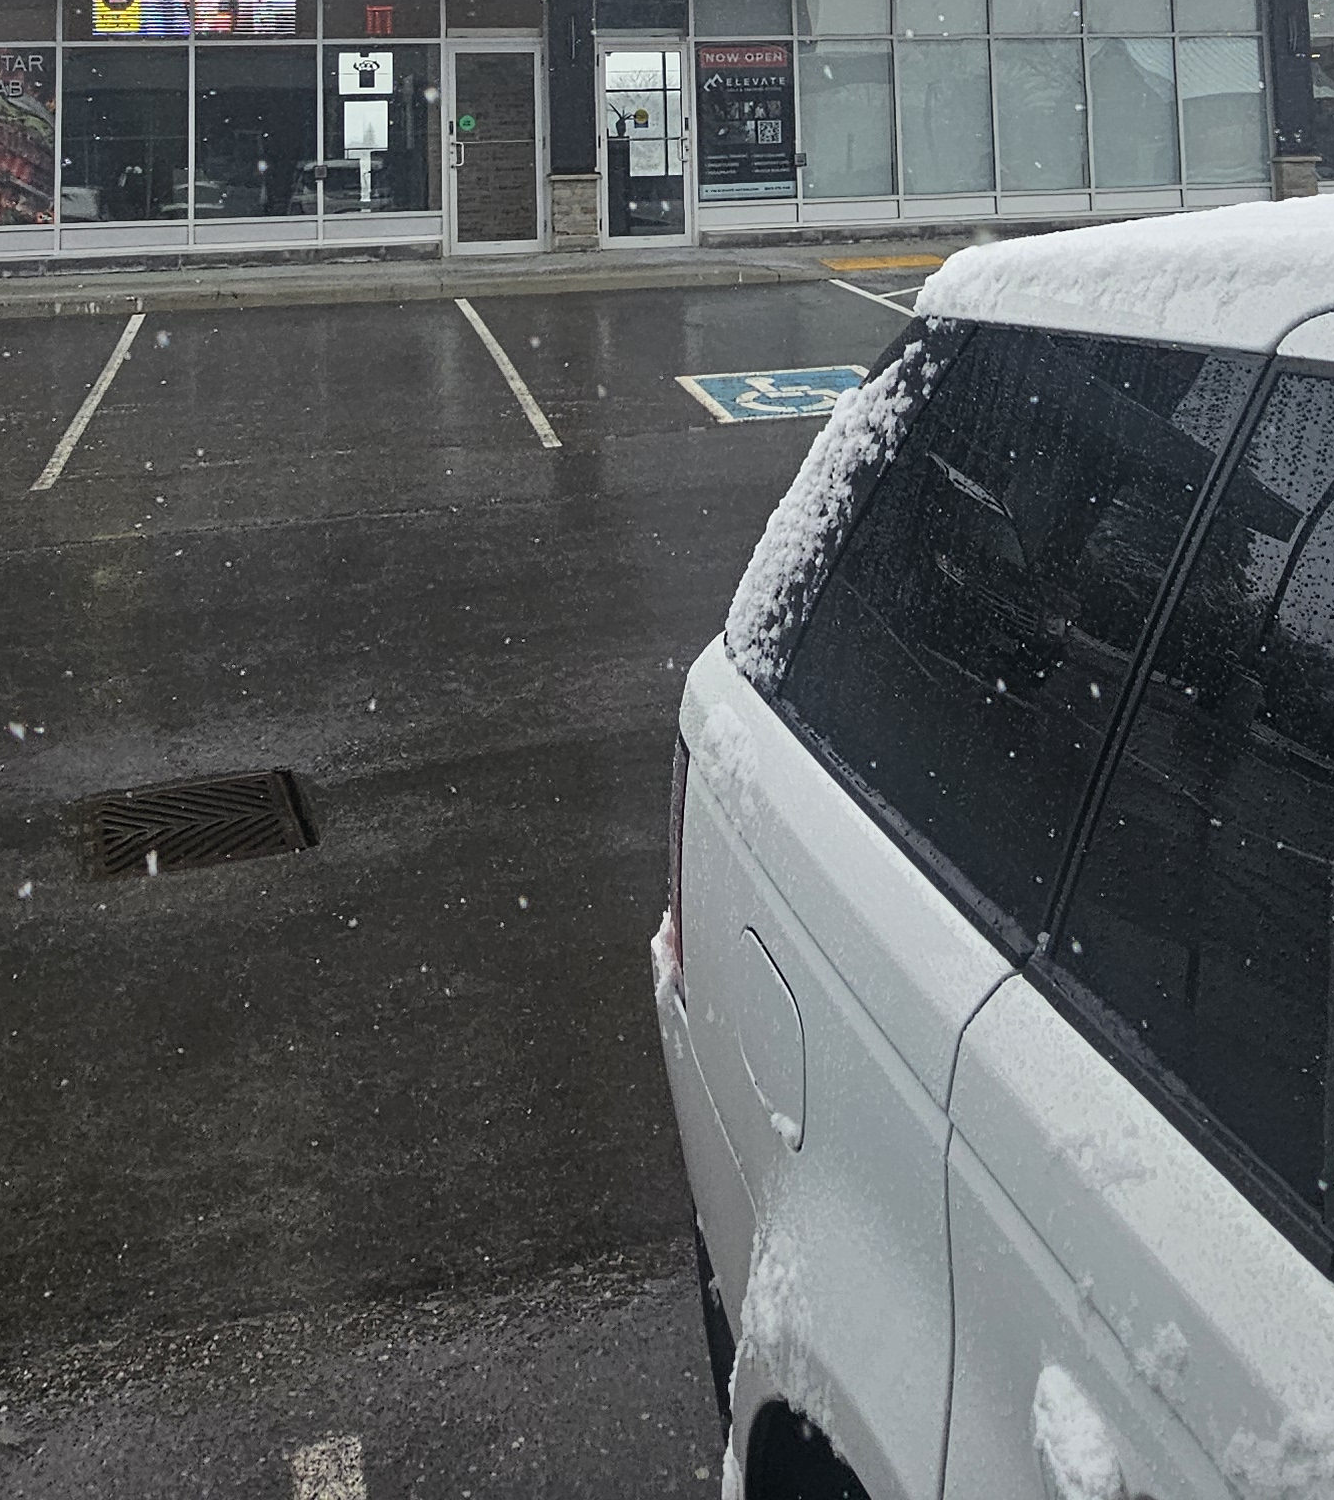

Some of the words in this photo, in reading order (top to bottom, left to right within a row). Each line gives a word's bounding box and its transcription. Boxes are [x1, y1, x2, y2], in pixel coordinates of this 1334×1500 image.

[705, 53, 740, 63] NOW
[744, 52, 783, 63] OPEN
[725, 77, 786, 87] ELEVATE
